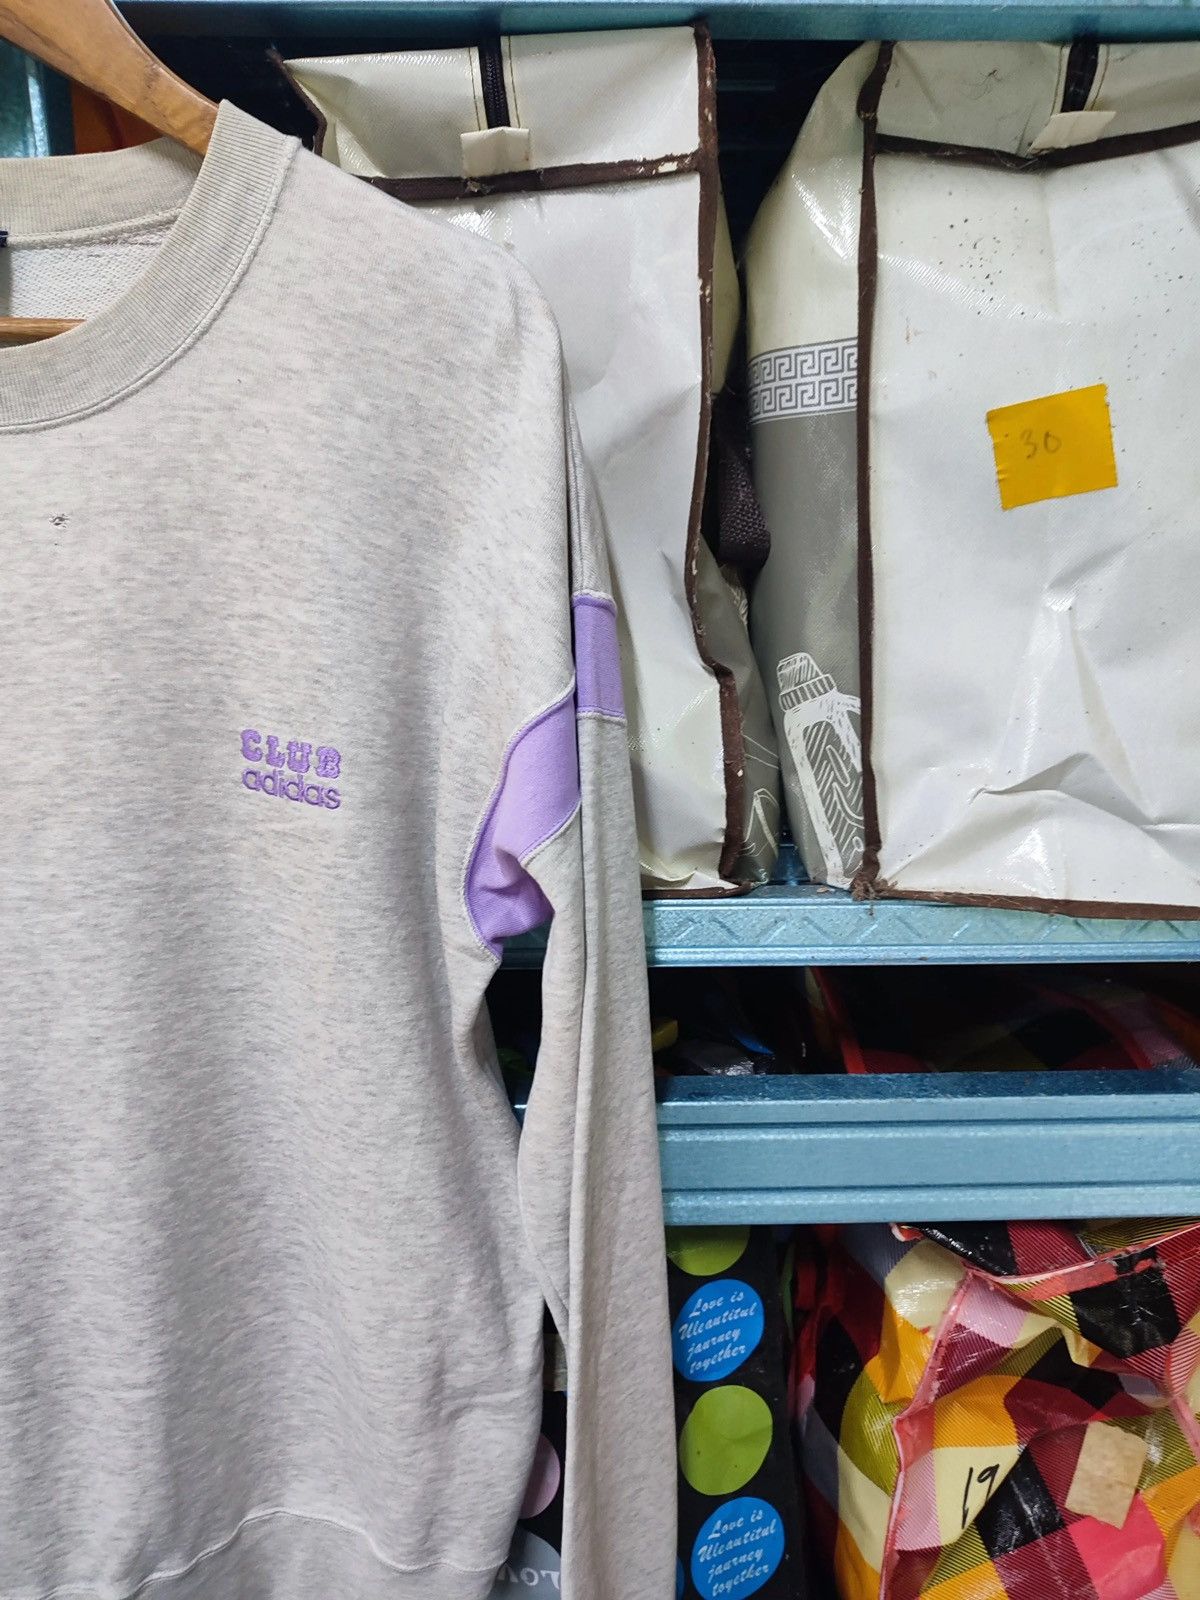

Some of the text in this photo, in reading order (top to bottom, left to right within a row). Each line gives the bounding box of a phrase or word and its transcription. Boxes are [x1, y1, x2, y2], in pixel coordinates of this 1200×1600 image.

[1020, 428, 1063, 460] 30
[240, 728, 342, 779] CLUB
[241, 768, 342, 810] adidas
[687, 1291, 745, 1319] Love is
[689, 1342, 747, 1375] together
[961, 1463, 1000, 1530] 19
[707, 1509, 764, 1540] Love is
[712, 1563, 769, 1597] together
